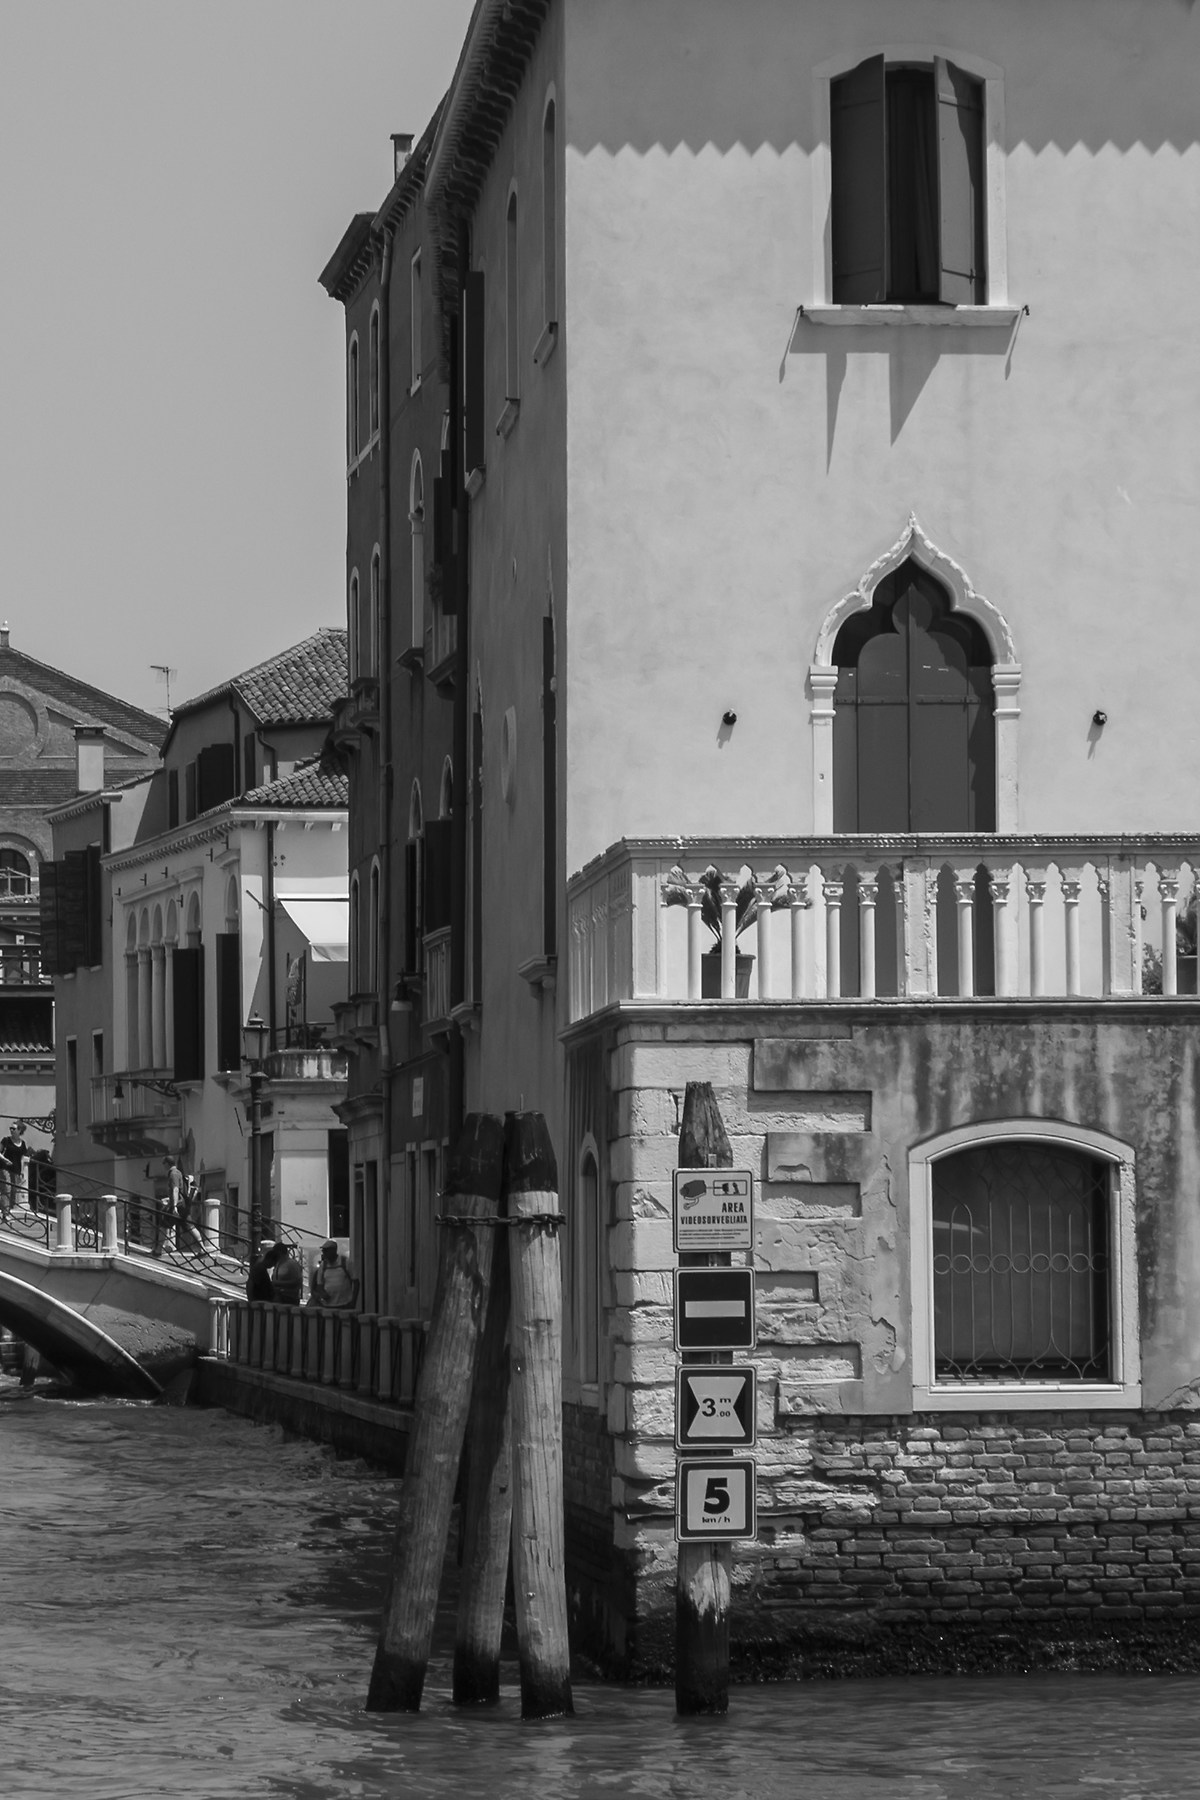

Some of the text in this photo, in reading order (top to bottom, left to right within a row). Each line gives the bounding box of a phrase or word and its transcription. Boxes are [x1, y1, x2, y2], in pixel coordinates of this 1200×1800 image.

[721, 1202, 744, 1213] AREA
[680, 1215, 748, 1225] VIDEOSORVEGLIATA
[703, 1477, 730, 1514] 5
